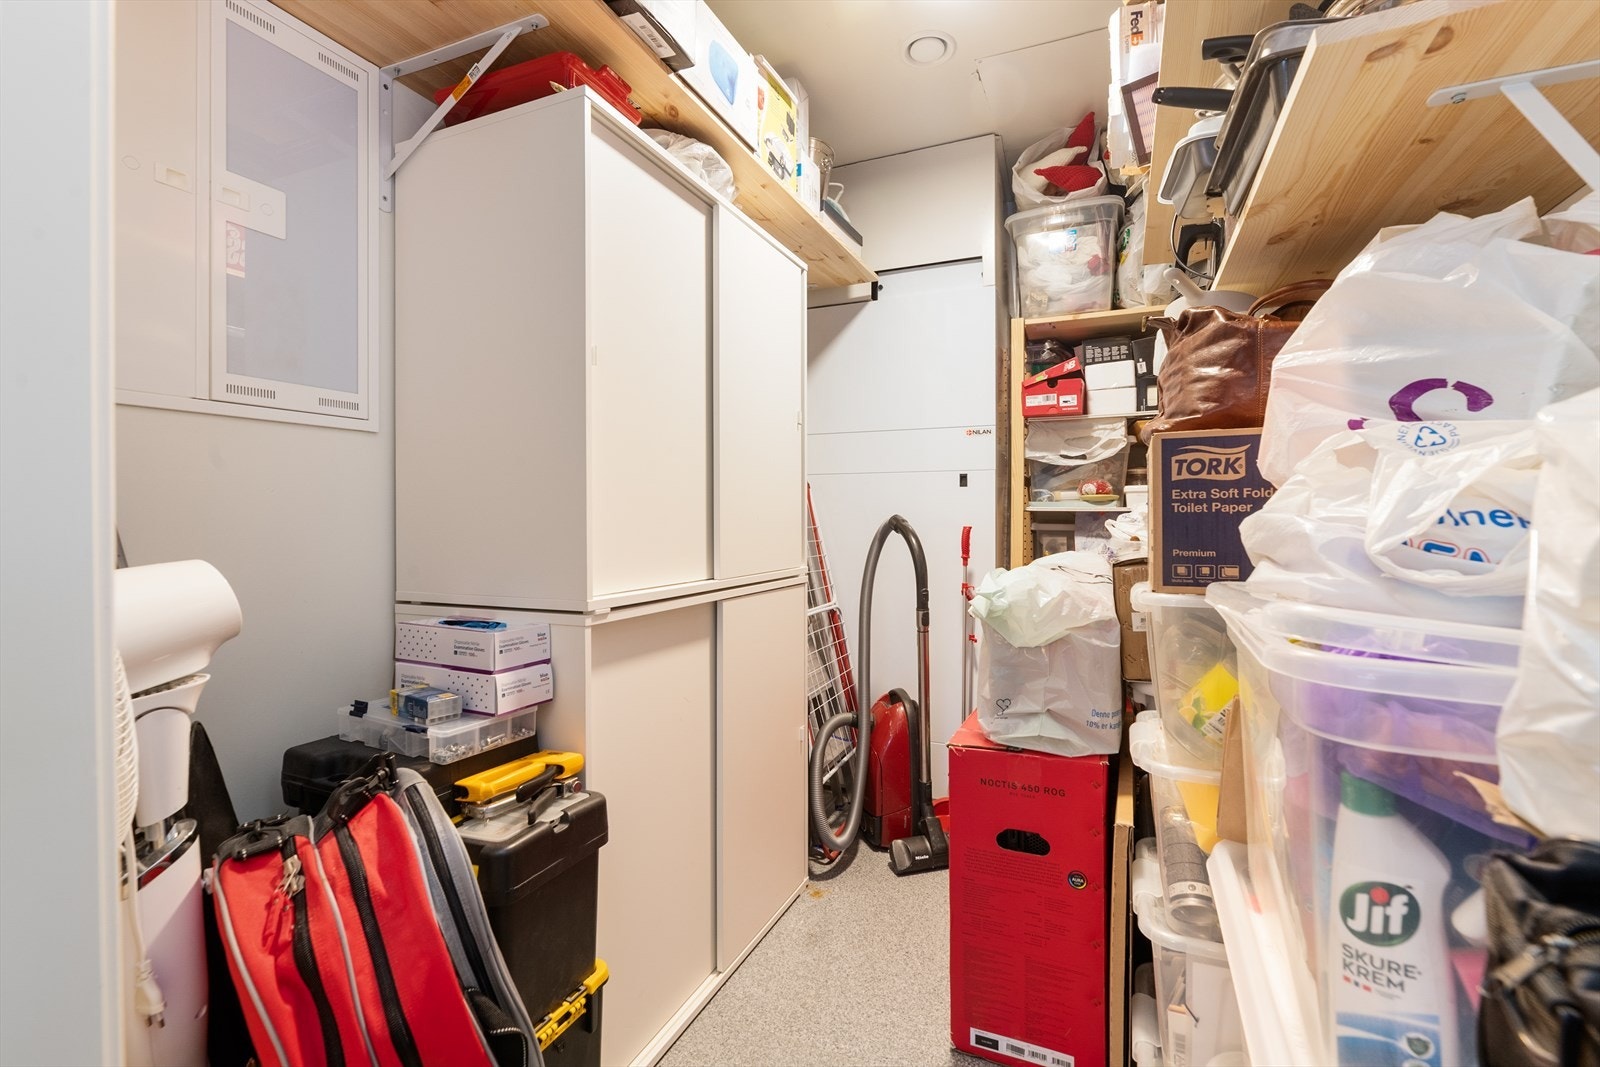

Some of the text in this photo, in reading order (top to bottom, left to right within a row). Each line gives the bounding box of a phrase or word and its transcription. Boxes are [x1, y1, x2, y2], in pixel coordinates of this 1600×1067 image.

[1174, 457, 1243, 476] TORK
[1171, 489, 1207, 499] Extra
[1210, 488, 1240, 499] Soft
[1171, 502, 1253, 515] Toilet Paper
[1172, 549, 1217, 558] Premium
[1091, 708, 1111, 719] Denne
[1086, 719, 1100, 730] 10%
[980, 777, 1018, 791] NOCTIS
[1021, 783, 1040, 794] 450
[1043, 786, 1067, 798] ROG
[1345, 885, 1410, 936] Jif
[1341, 942, 1423, 981] SKURE-
[1341, 957, 1407, 994] KREM
